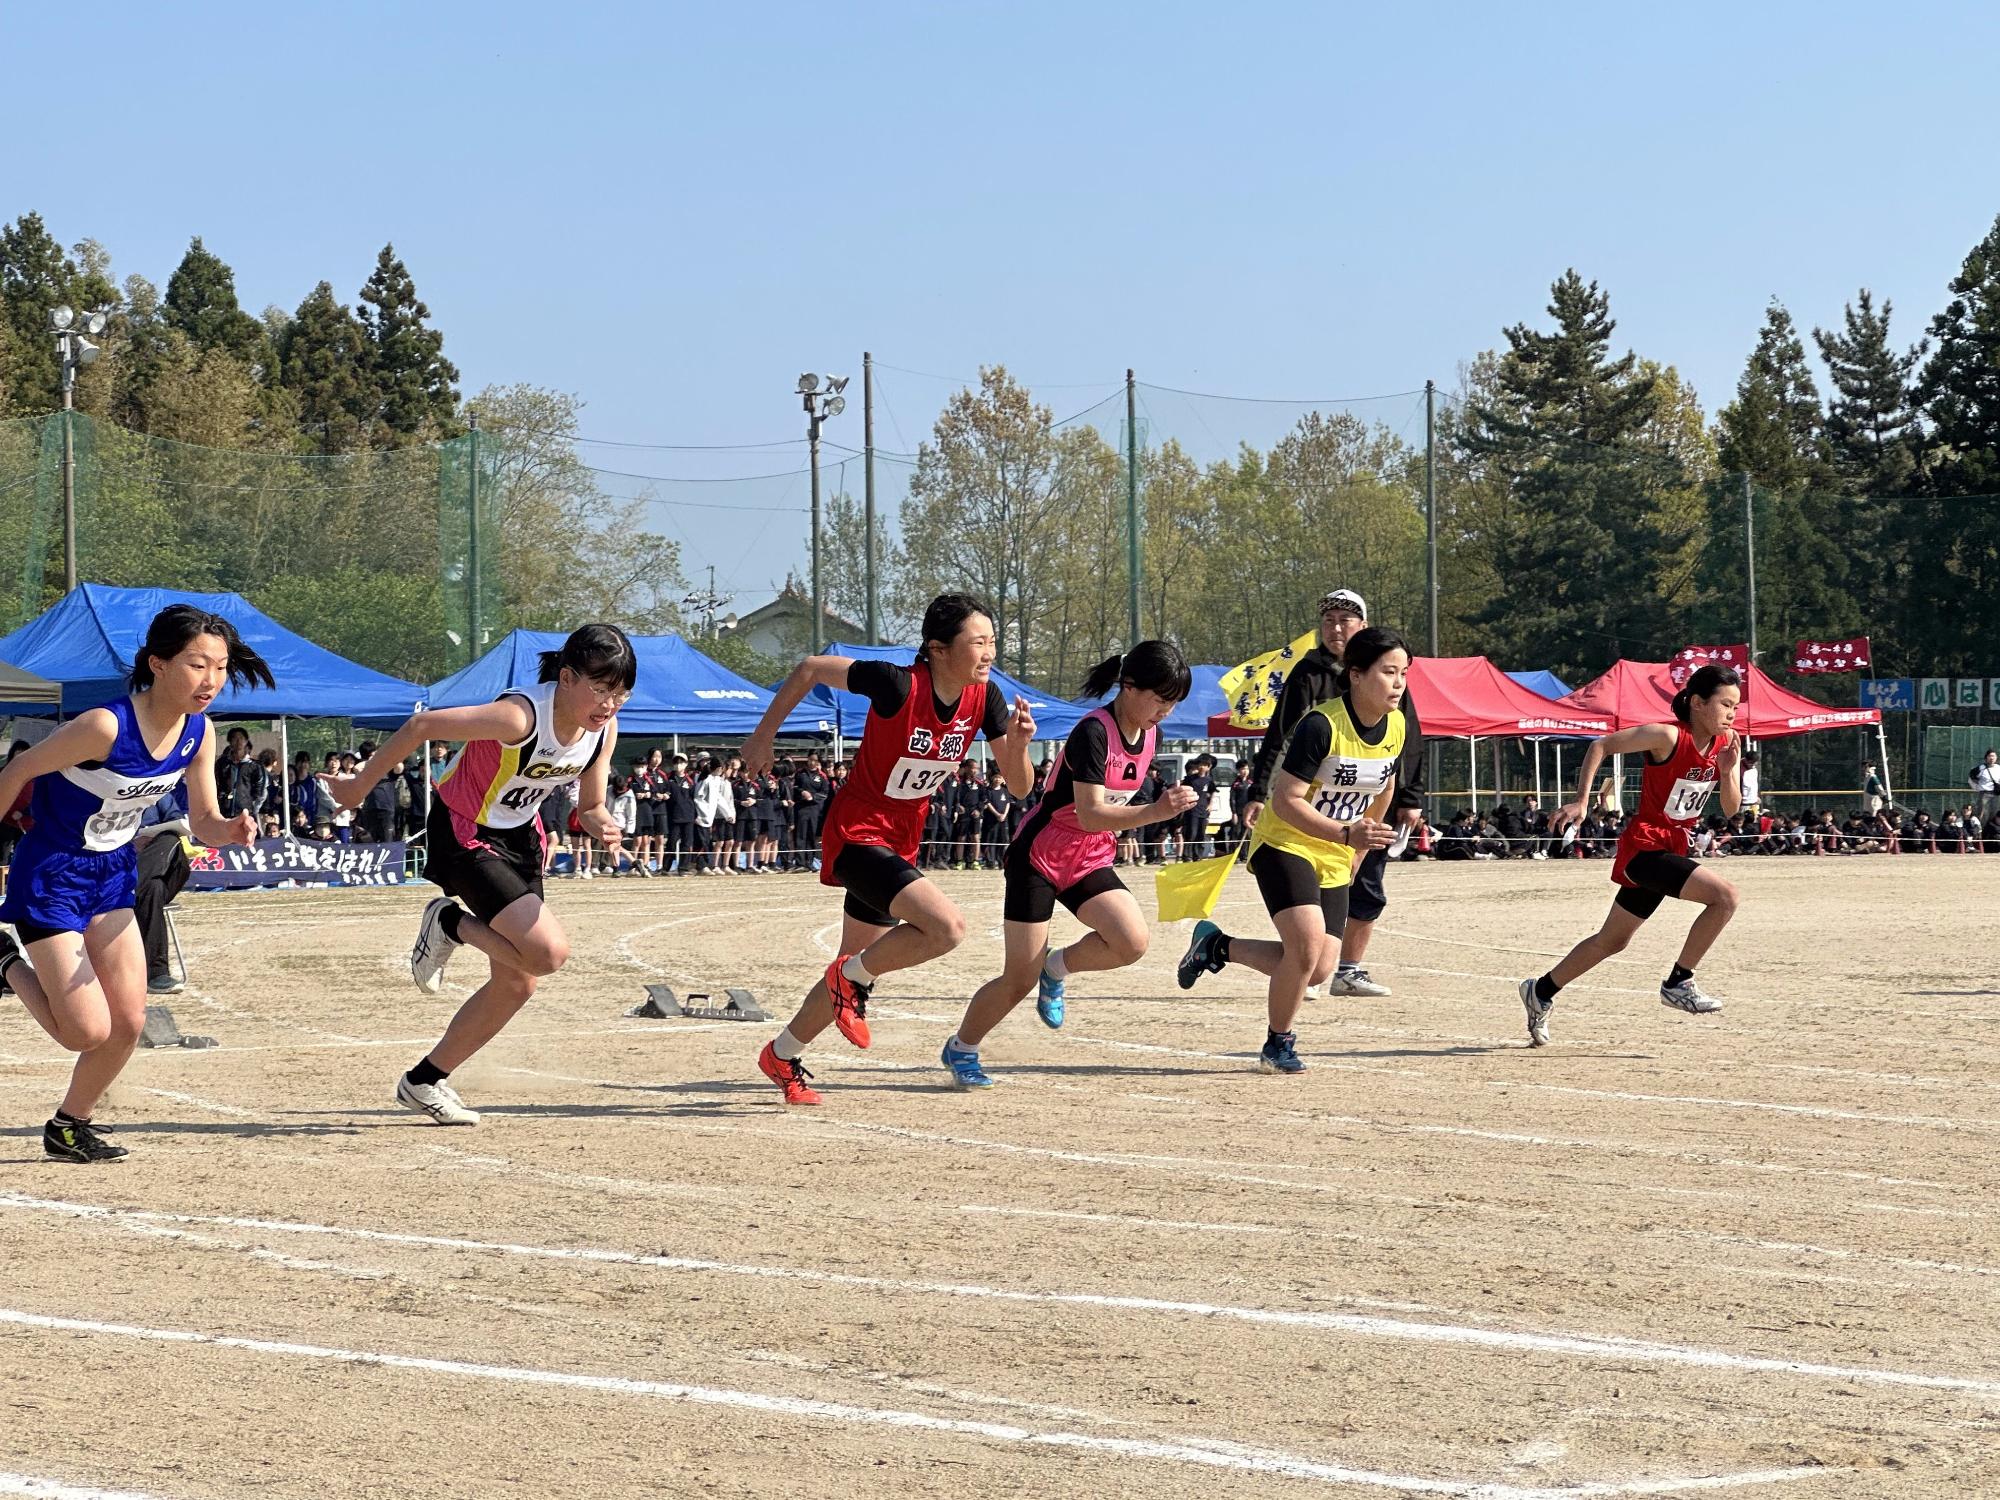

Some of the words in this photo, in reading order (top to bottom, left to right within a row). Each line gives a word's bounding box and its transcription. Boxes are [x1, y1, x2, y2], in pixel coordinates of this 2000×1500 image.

[908, 727, 964, 760] 西郷
[897, 768, 946, 790] 132
[1675, 788, 1710, 811] 130
